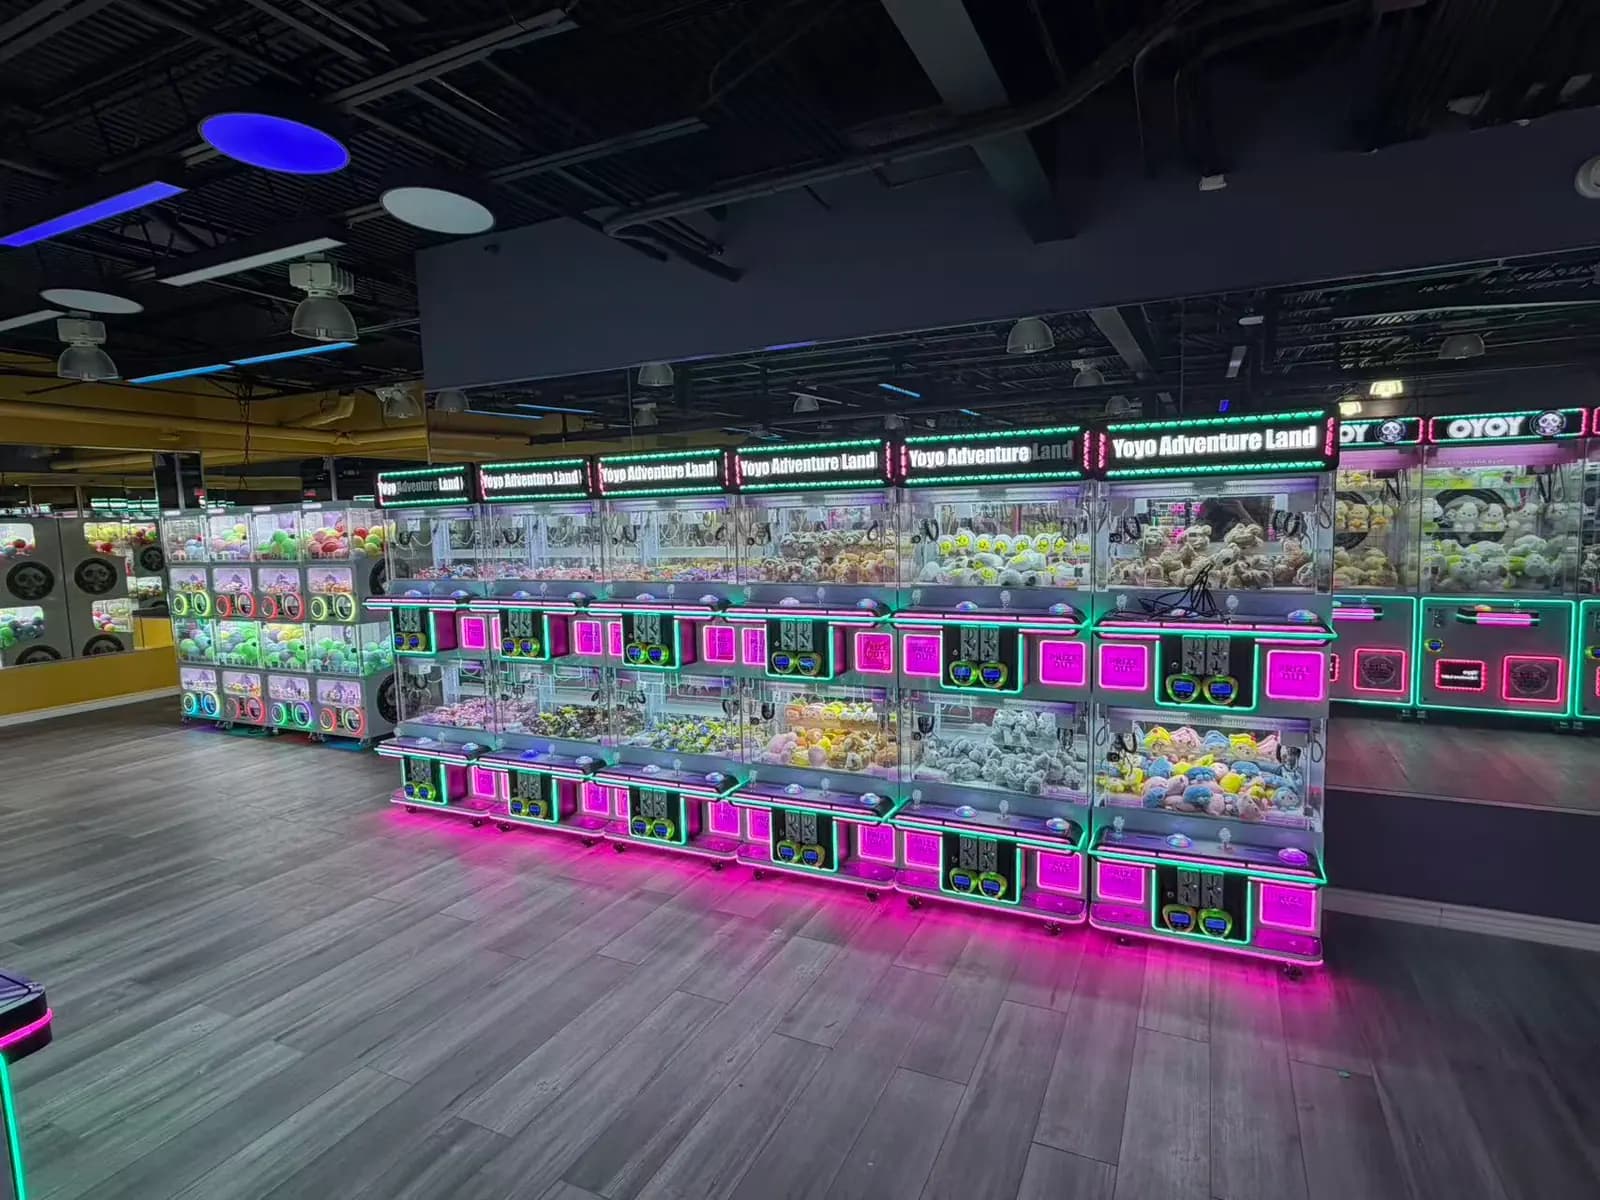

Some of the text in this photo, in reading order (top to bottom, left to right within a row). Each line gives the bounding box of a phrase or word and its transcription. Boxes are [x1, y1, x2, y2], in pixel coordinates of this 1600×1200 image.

[909, 440, 1073, 469] Yoyo Adventure Land
[1112, 426, 1318, 460] Yoyo Adventure Land
[602, 460, 715, 483] Yoyo Adventure Land
[740, 451, 876, 477] Yoyo Adventure Land
[438, 476, 460, 491] Land
[504, 472, 553, 488] Adventure
[553, 469, 579, 485] Land
